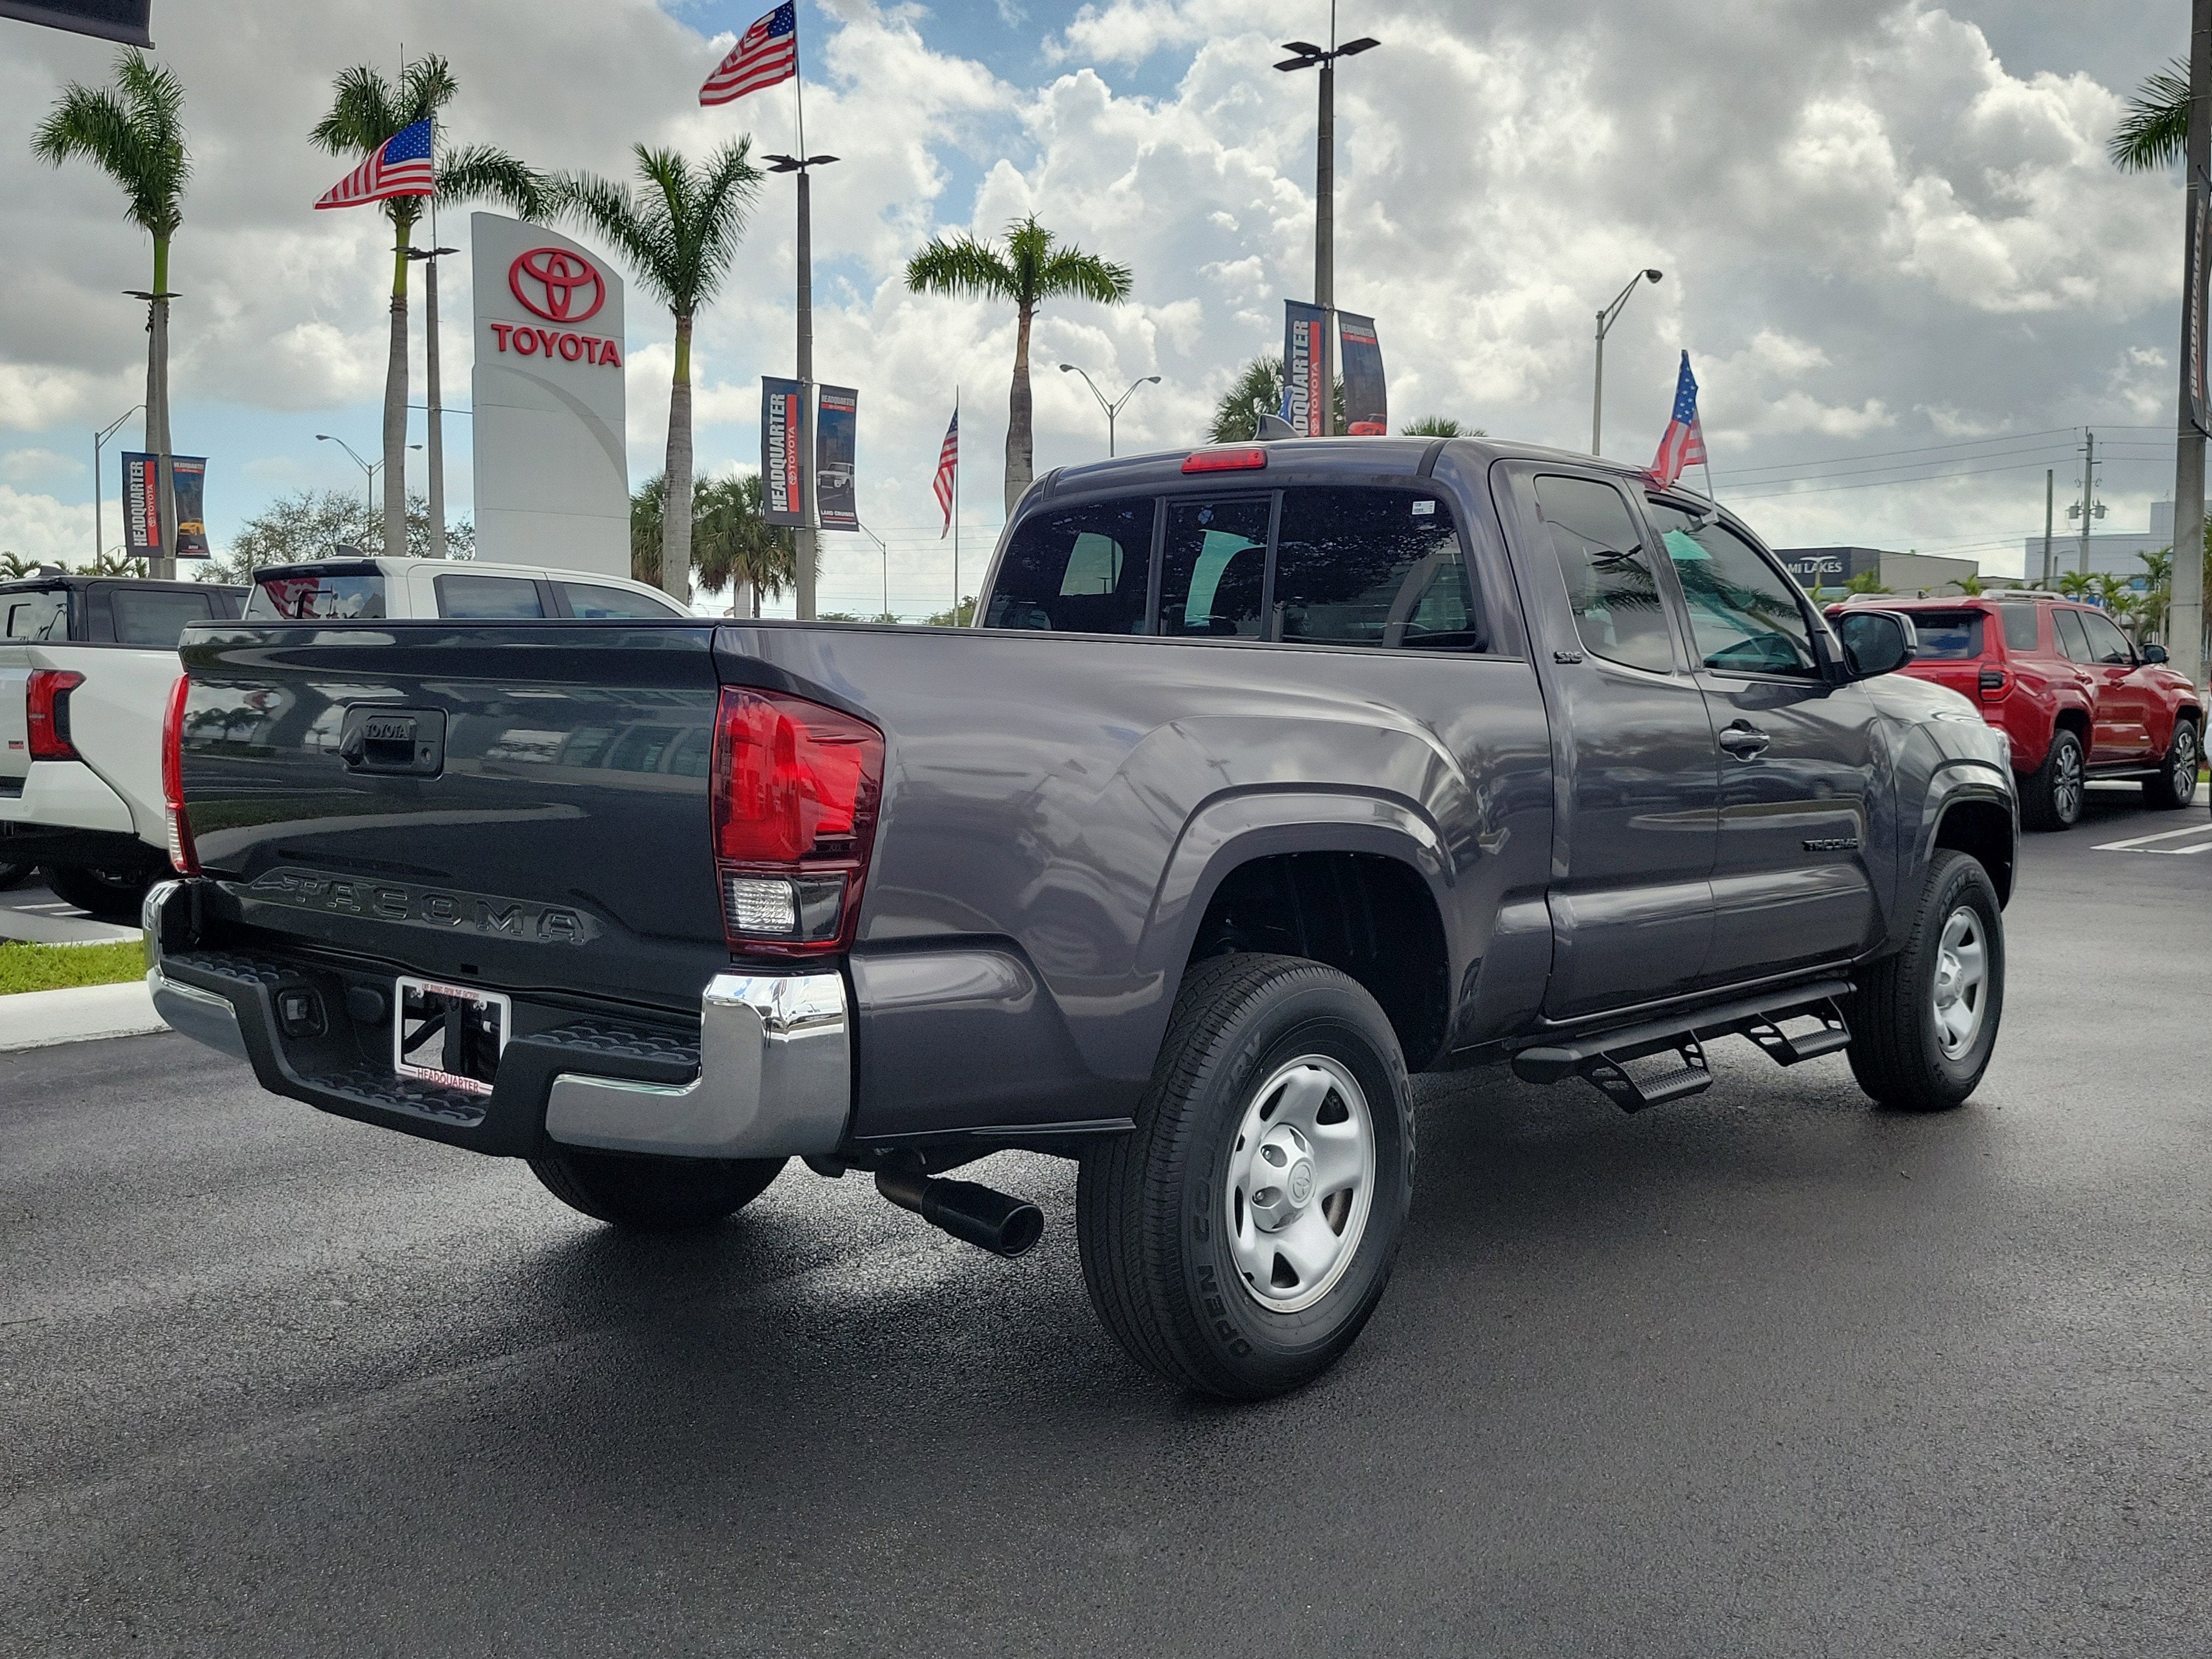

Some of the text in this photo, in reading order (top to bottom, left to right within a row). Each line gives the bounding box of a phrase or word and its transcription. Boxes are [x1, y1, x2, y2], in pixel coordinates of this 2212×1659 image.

[491, 324, 622, 367] TOYOTA
[1311, 362, 1319, 416] TOYOTA
[770, 393, 788, 512] HEADQUARTER
[130, 461, 148, 546] HEADQUARTER
[1804, 562, 1843, 573] LAKES
[366, 724, 408, 738] TOYOTA
[282, 873, 585, 944] TACOMA
[417, 1068, 479, 1093] HEADQUARTER
